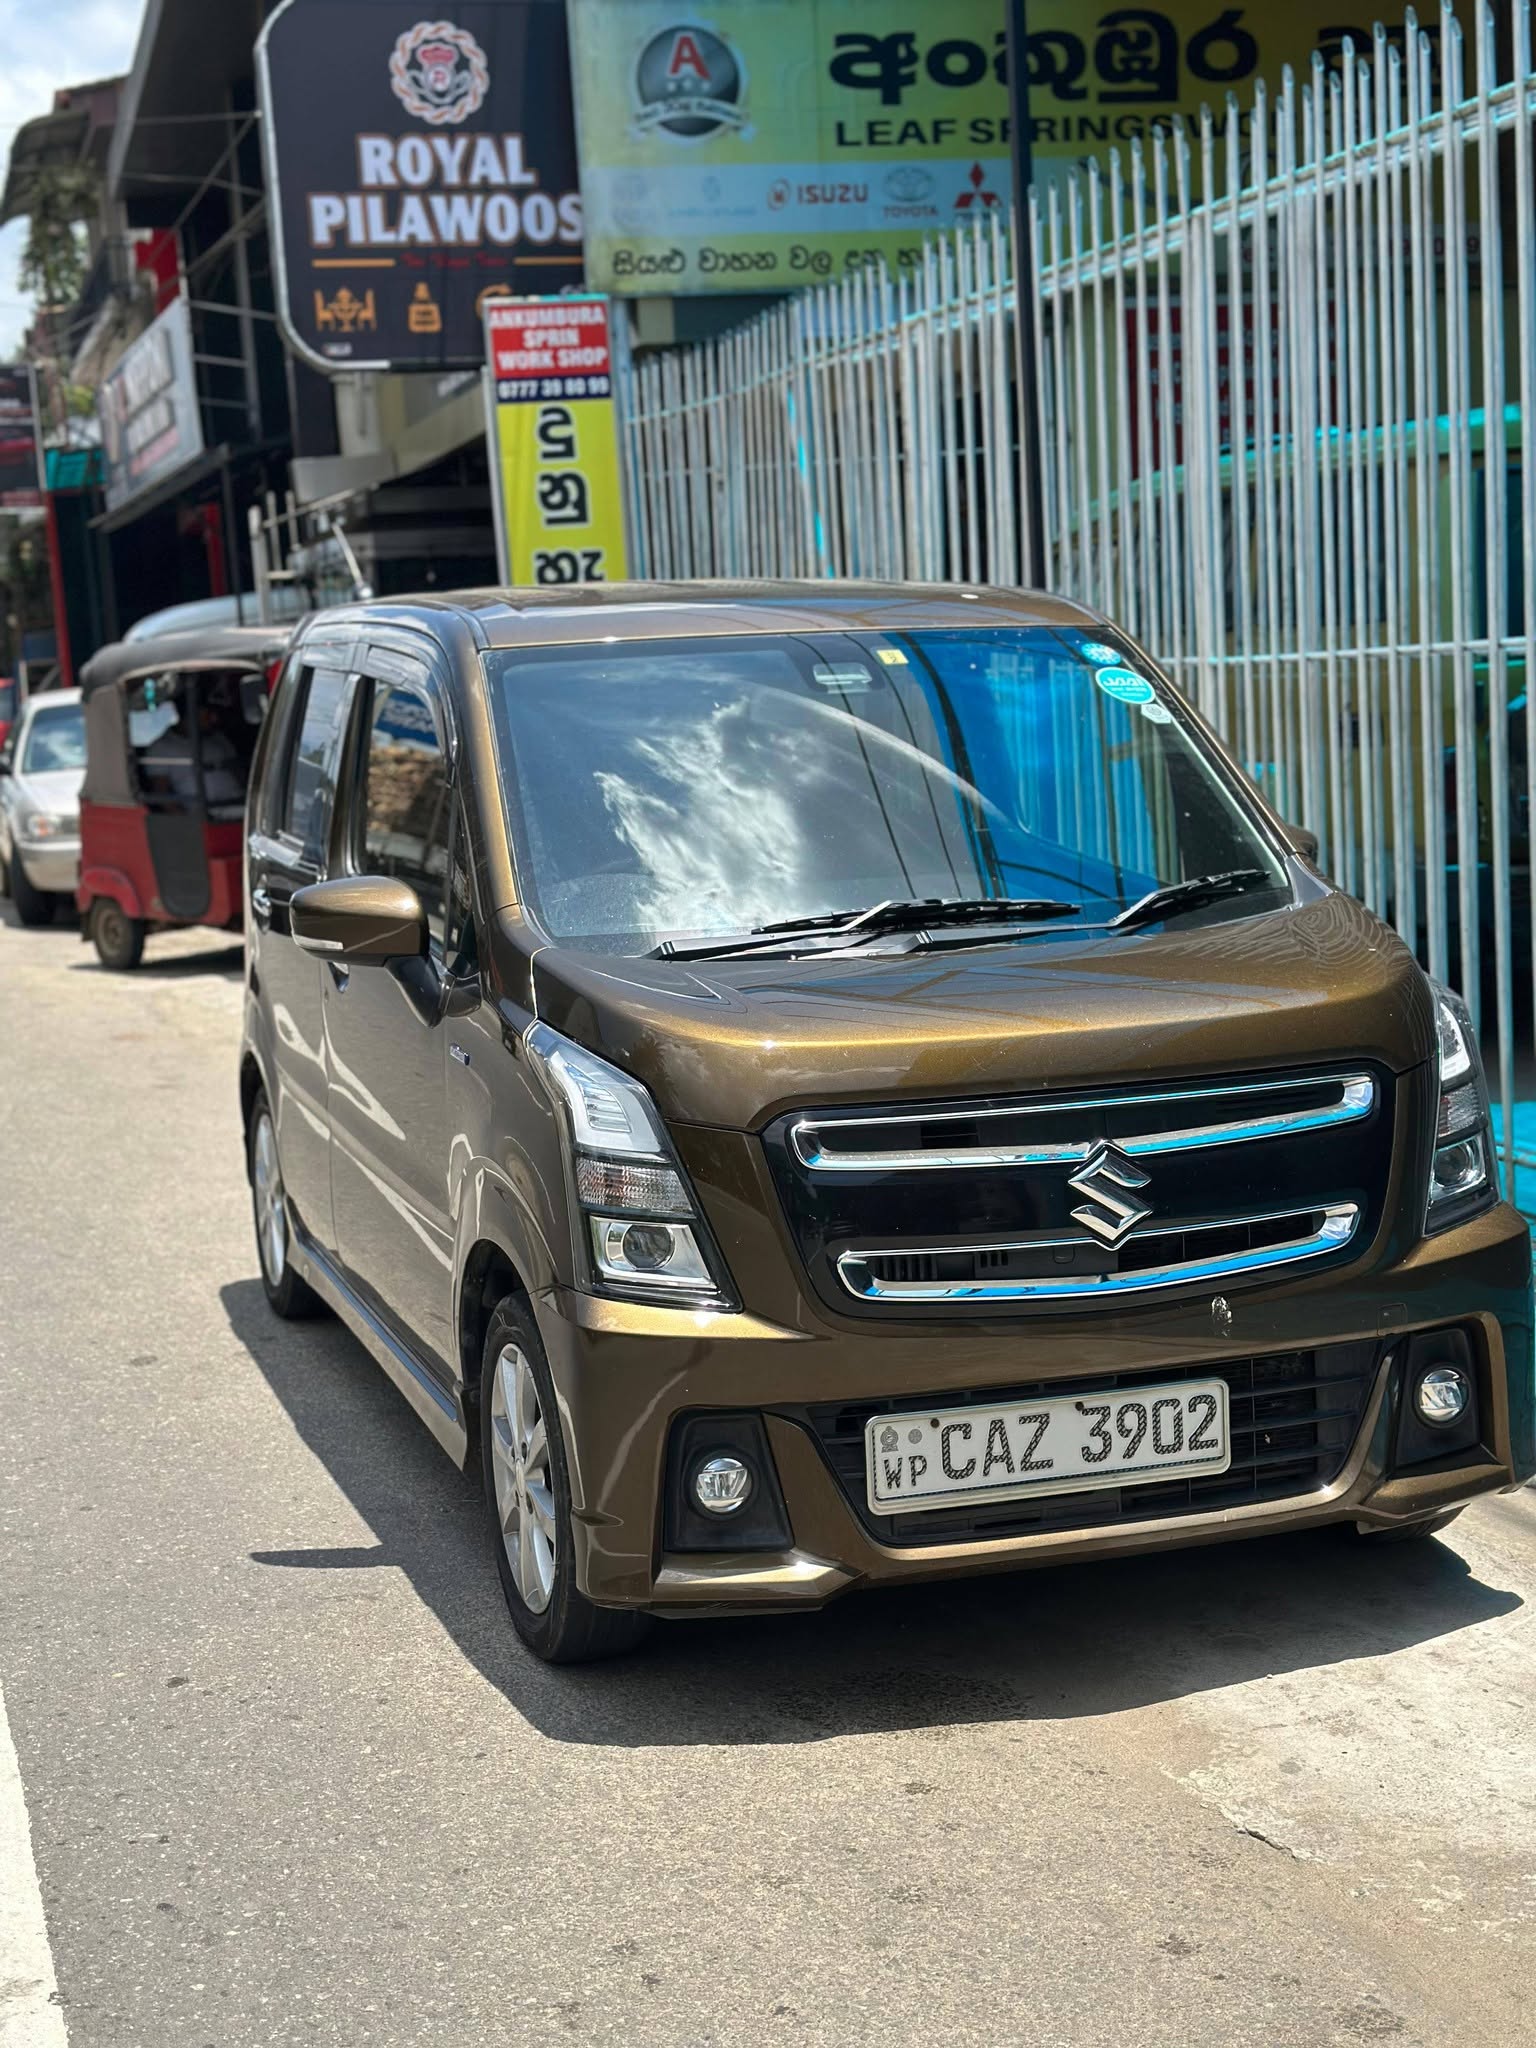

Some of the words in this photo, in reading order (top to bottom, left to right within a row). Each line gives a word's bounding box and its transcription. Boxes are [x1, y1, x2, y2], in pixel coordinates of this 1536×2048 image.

[835, 118, 957, 147] LEAF
[357, 135, 537, 187] ROYAL
[797, 184, 869, 205] ISUZU
[308, 193, 584, 246] PILAWOOS
[883, 205, 939, 218] TOYOTA
[788, 244, 833, 275] වල
[489, 305, 606, 330] ANKUMBURA
[521, 327, 580, 349] SPRIN
[497, 350, 555, 371] WORK
[557, 347, 608, 368] SHOP
[883, 1454, 928, 1490] WP
[941, 1412, 1054, 1481] CAZ
[1079, 1394, 1219, 1464] 3902
